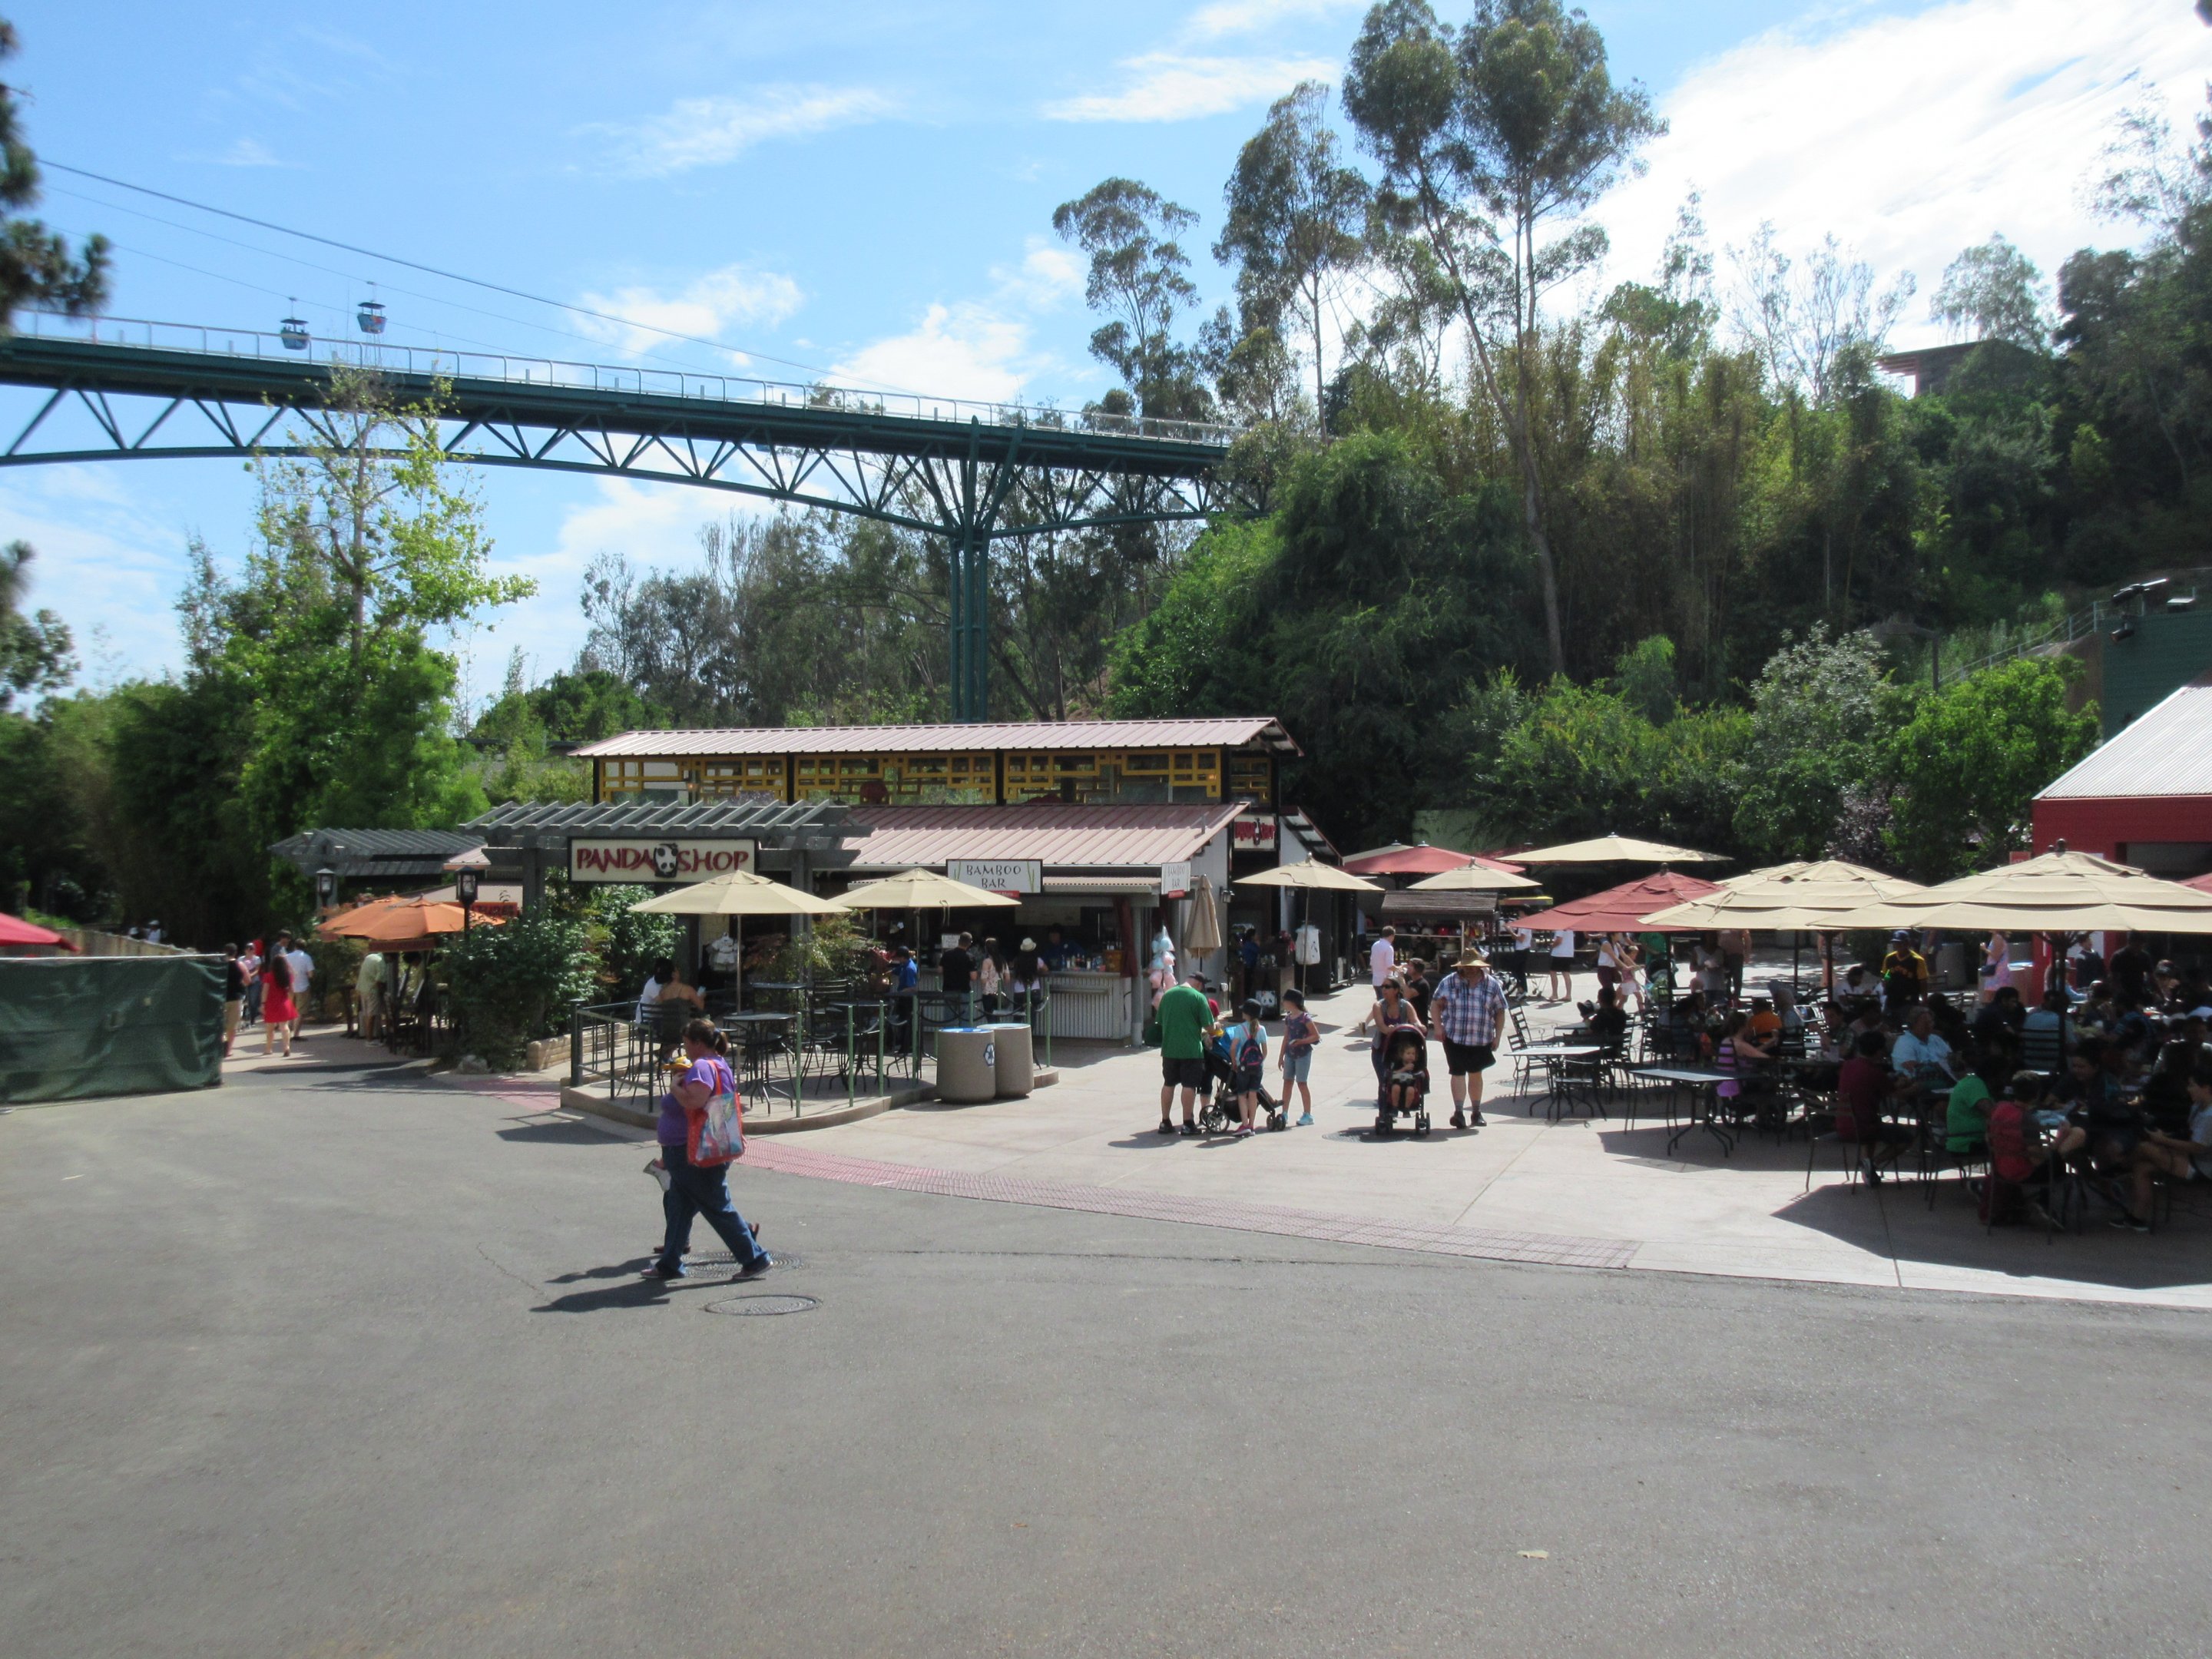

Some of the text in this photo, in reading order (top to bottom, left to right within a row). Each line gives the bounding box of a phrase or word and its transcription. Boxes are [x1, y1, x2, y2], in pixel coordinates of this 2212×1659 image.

[577, 848, 749, 873] PANDA SHOP
[966, 865, 1022, 876] BAMBOO
[982, 878, 1006, 889] BAR
